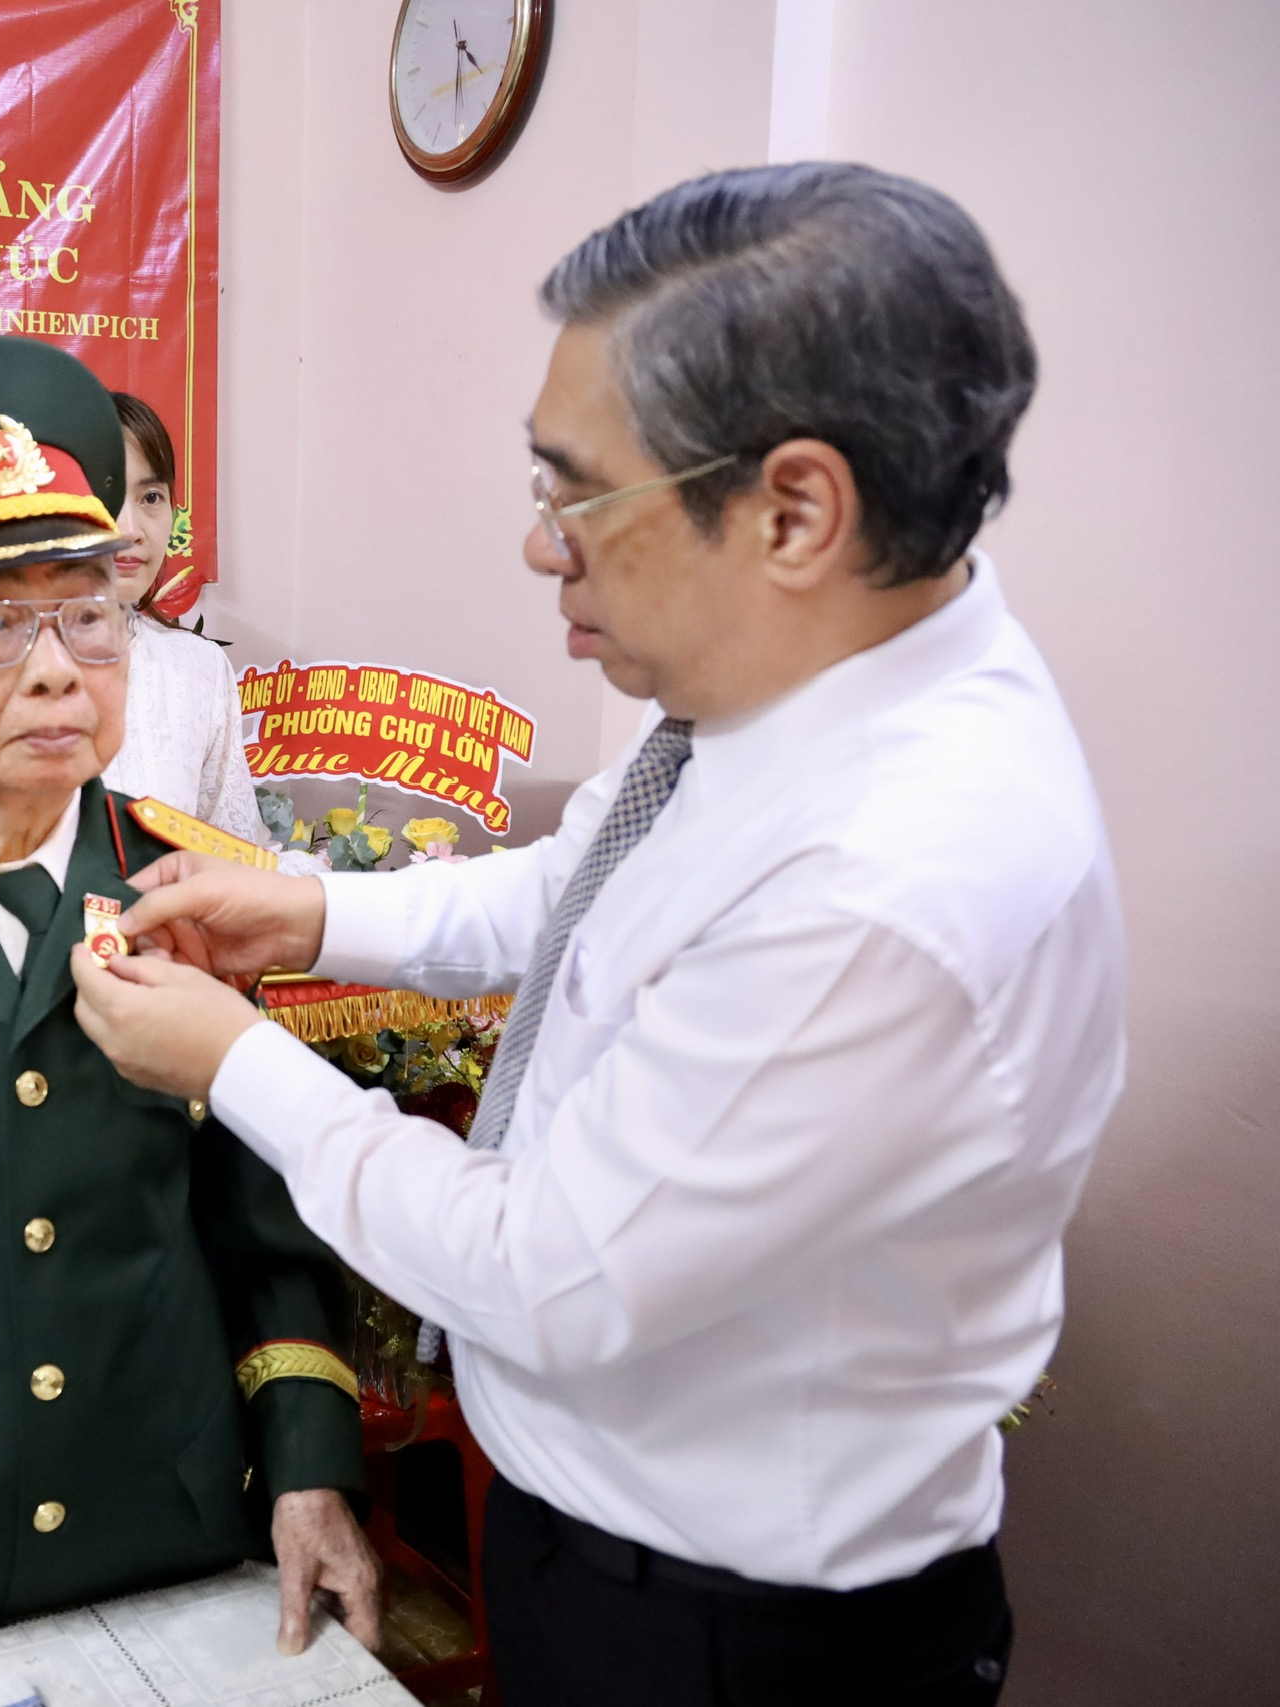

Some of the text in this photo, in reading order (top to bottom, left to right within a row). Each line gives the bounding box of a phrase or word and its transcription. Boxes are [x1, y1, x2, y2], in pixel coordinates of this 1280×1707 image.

[264, 703, 494, 773] PHƯỜNG CHỢ LỚN
[275, 663, 297, 705] ỦY
[306, 669, 348, 701] HĐND
[358, 670, 399, 706] UBND
[409, 677, 466, 727] UBMTTQ
[468, 695, 500, 742] VIỆT
[500, 711, 532, 758] NAM
[362, 750, 510, 829] Mừng
